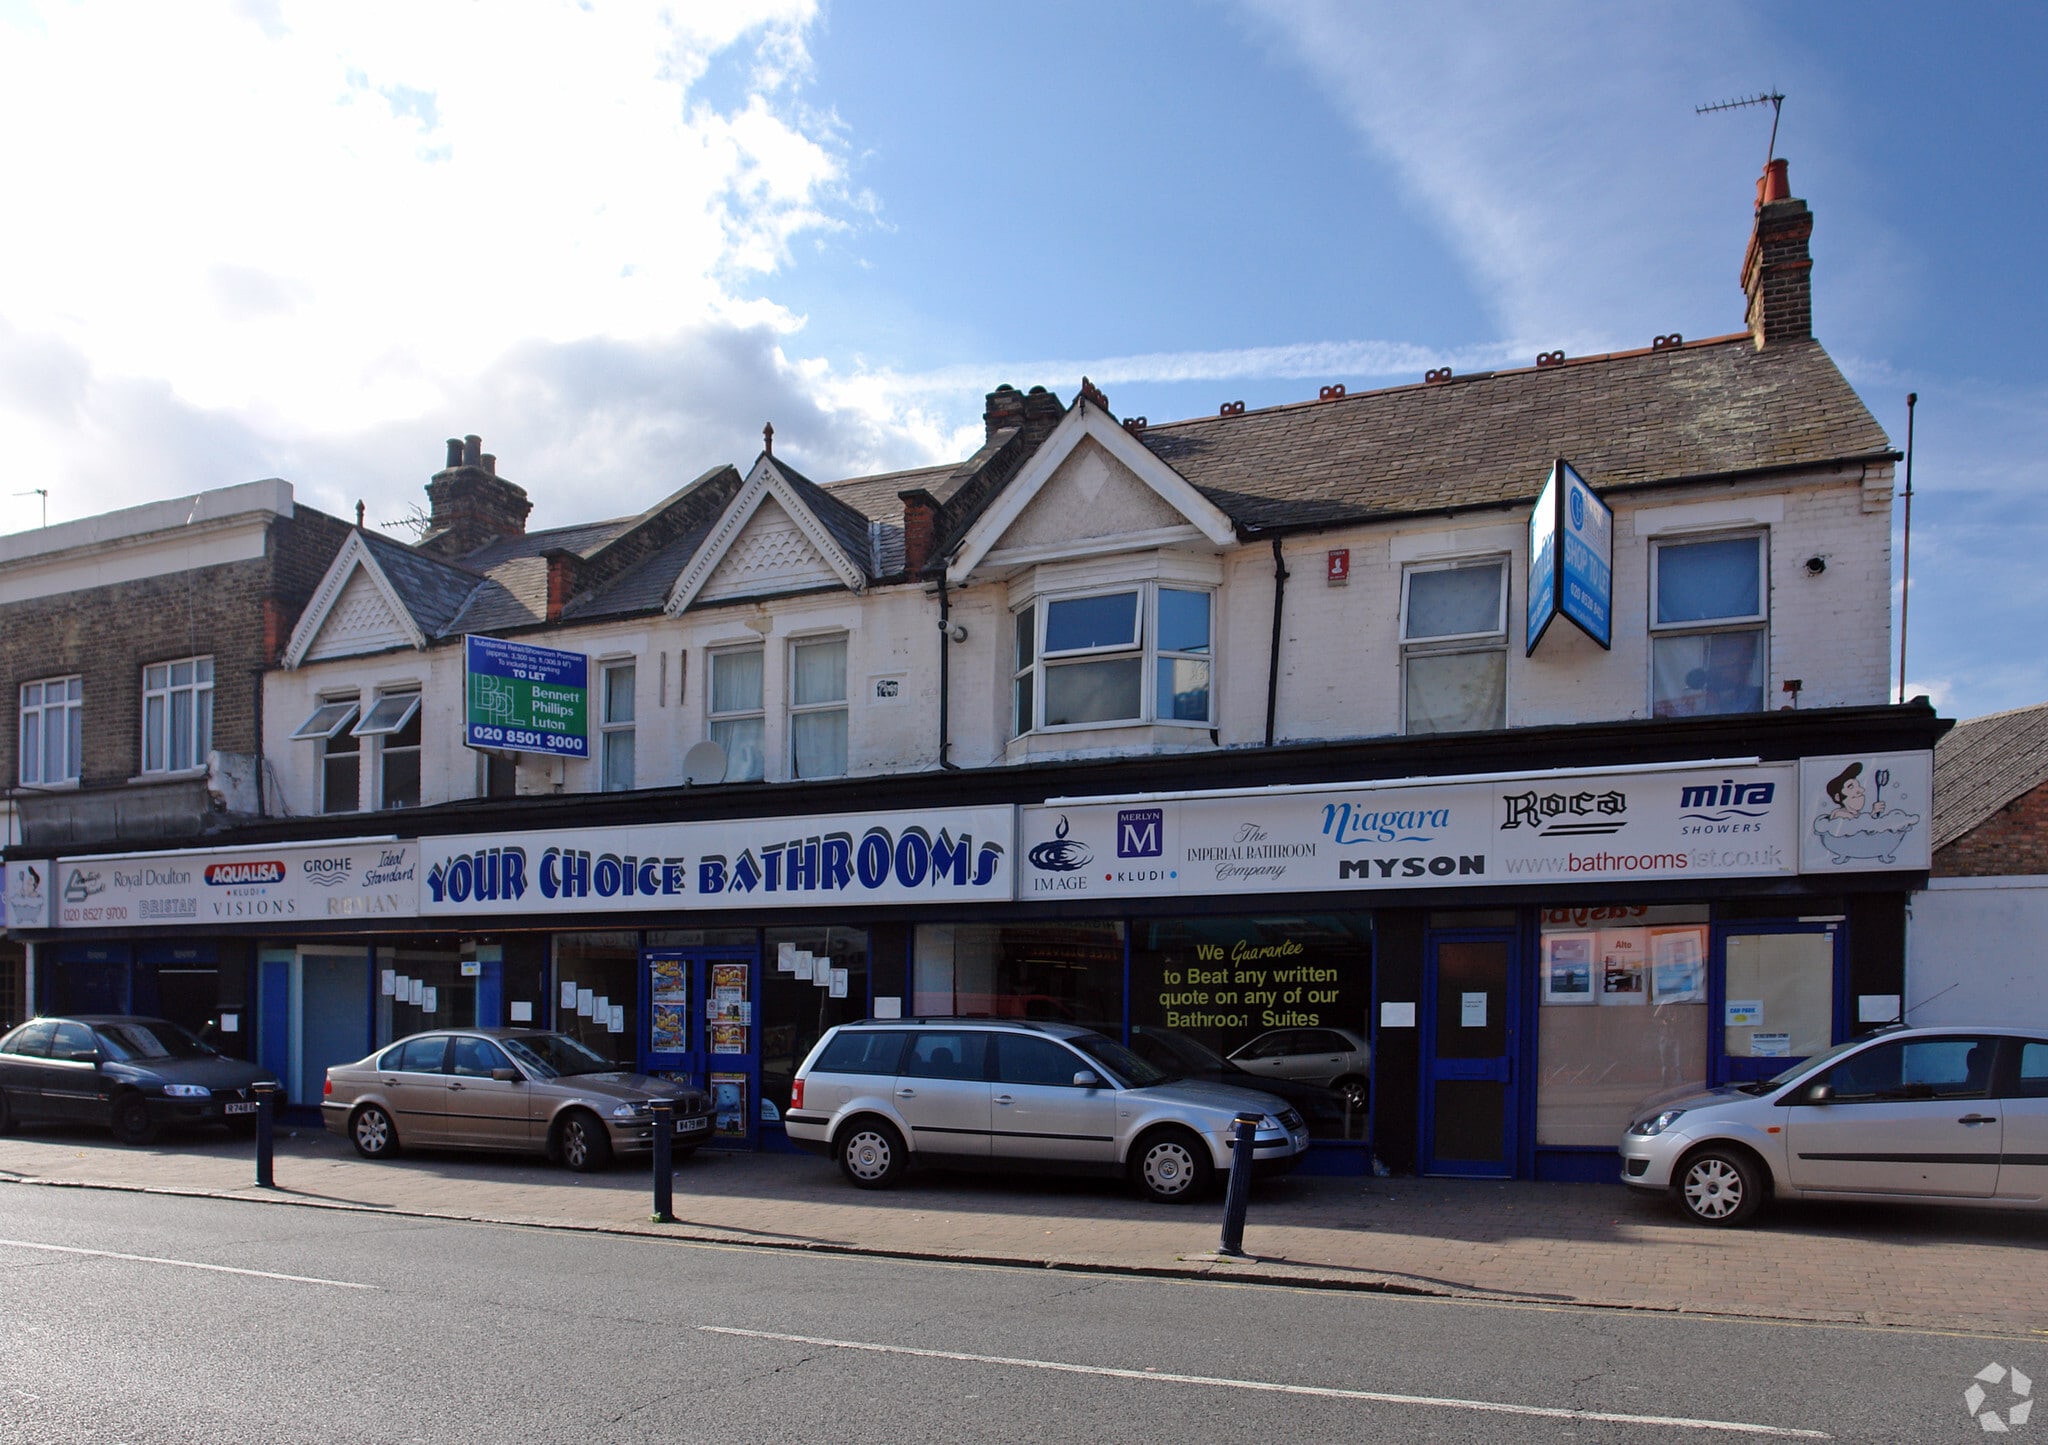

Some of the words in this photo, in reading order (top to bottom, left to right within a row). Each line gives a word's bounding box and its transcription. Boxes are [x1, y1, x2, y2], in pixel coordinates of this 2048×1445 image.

[1565, 536, 1588, 576] SHOP
[1589, 552, 1600, 586] TO
[474, 639, 507, 650] Substantial
[506, 660, 527, 669] include
[538, 664, 560, 675] parking
[512, 669, 526, 679] TO
[528, 671, 546, 681] LET
[532, 686, 579, 703] Bennett
[532, 700, 574, 717] Phillips
[532, 716, 566, 730] Luton
[474, 726, 503, 741] 020
[506, 730, 541, 745] 8501
[546, 735, 583, 750] 3000
[1680, 779, 1775, 808] mira
[1120, 811, 1160, 822] MERLYN
[1501, 790, 1628, 830] Roca
[1233, 822, 1268, 843] The
[1321, 802, 1449, 844] Niagara
[1682, 823, 1762, 835] SHOWERS
[1121, 823, 1158, 854] M
[377, 848, 406, 868] Ideal
[1187, 845, 1244, 862] IMPERIAL
[1246, 843, 1316, 860] BATHROOM
[303, 857, 352, 873] GROHE
[427, 846, 528, 902] YOUR
[539, 846, 685, 898] CHOICE
[699, 825, 1005, 895] BATHROOMS
[1214, 862, 1288, 881] Company
[1339, 855, 1485, 879] MYSON
[114, 869, 143, 893] Royal
[145, 867, 191, 886] Doulton
[211, 863, 279, 884] AQUALISA
[361, 863, 416, 887] Standard
[1117, 870, 1165, 882] KLUDI
[233, 888, 259, 896] KLUDI
[1034, 877, 1087, 892] IMAGE
[64, 908, 80, 921] 020
[82, 907, 103, 920] 8527
[106, 906, 128, 920] 9700
[139, 898, 197, 918] BRISTAN
[213, 898, 295, 916] VISIONS
[1197, 944, 1225, 960] We
[1231, 938, 1304, 968] Guarantee
[1616, 940, 1633, 949] Alto
[1163, 969, 1181, 985] to
[1187, 968, 1229, 984] Beat
[1234, 970, 1267, 988] any
[1273, 966, 1338, 983] written
[1159, 990, 1209, 1009] quote
[1215, 994, 1238, 1005] on
[1244, 991, 1277, 1008] any
[1283, 987, 1302, 1003] of
[1307, 989, 1339, 1003] our
[1262, 1009, 1320, 1027] Suites
